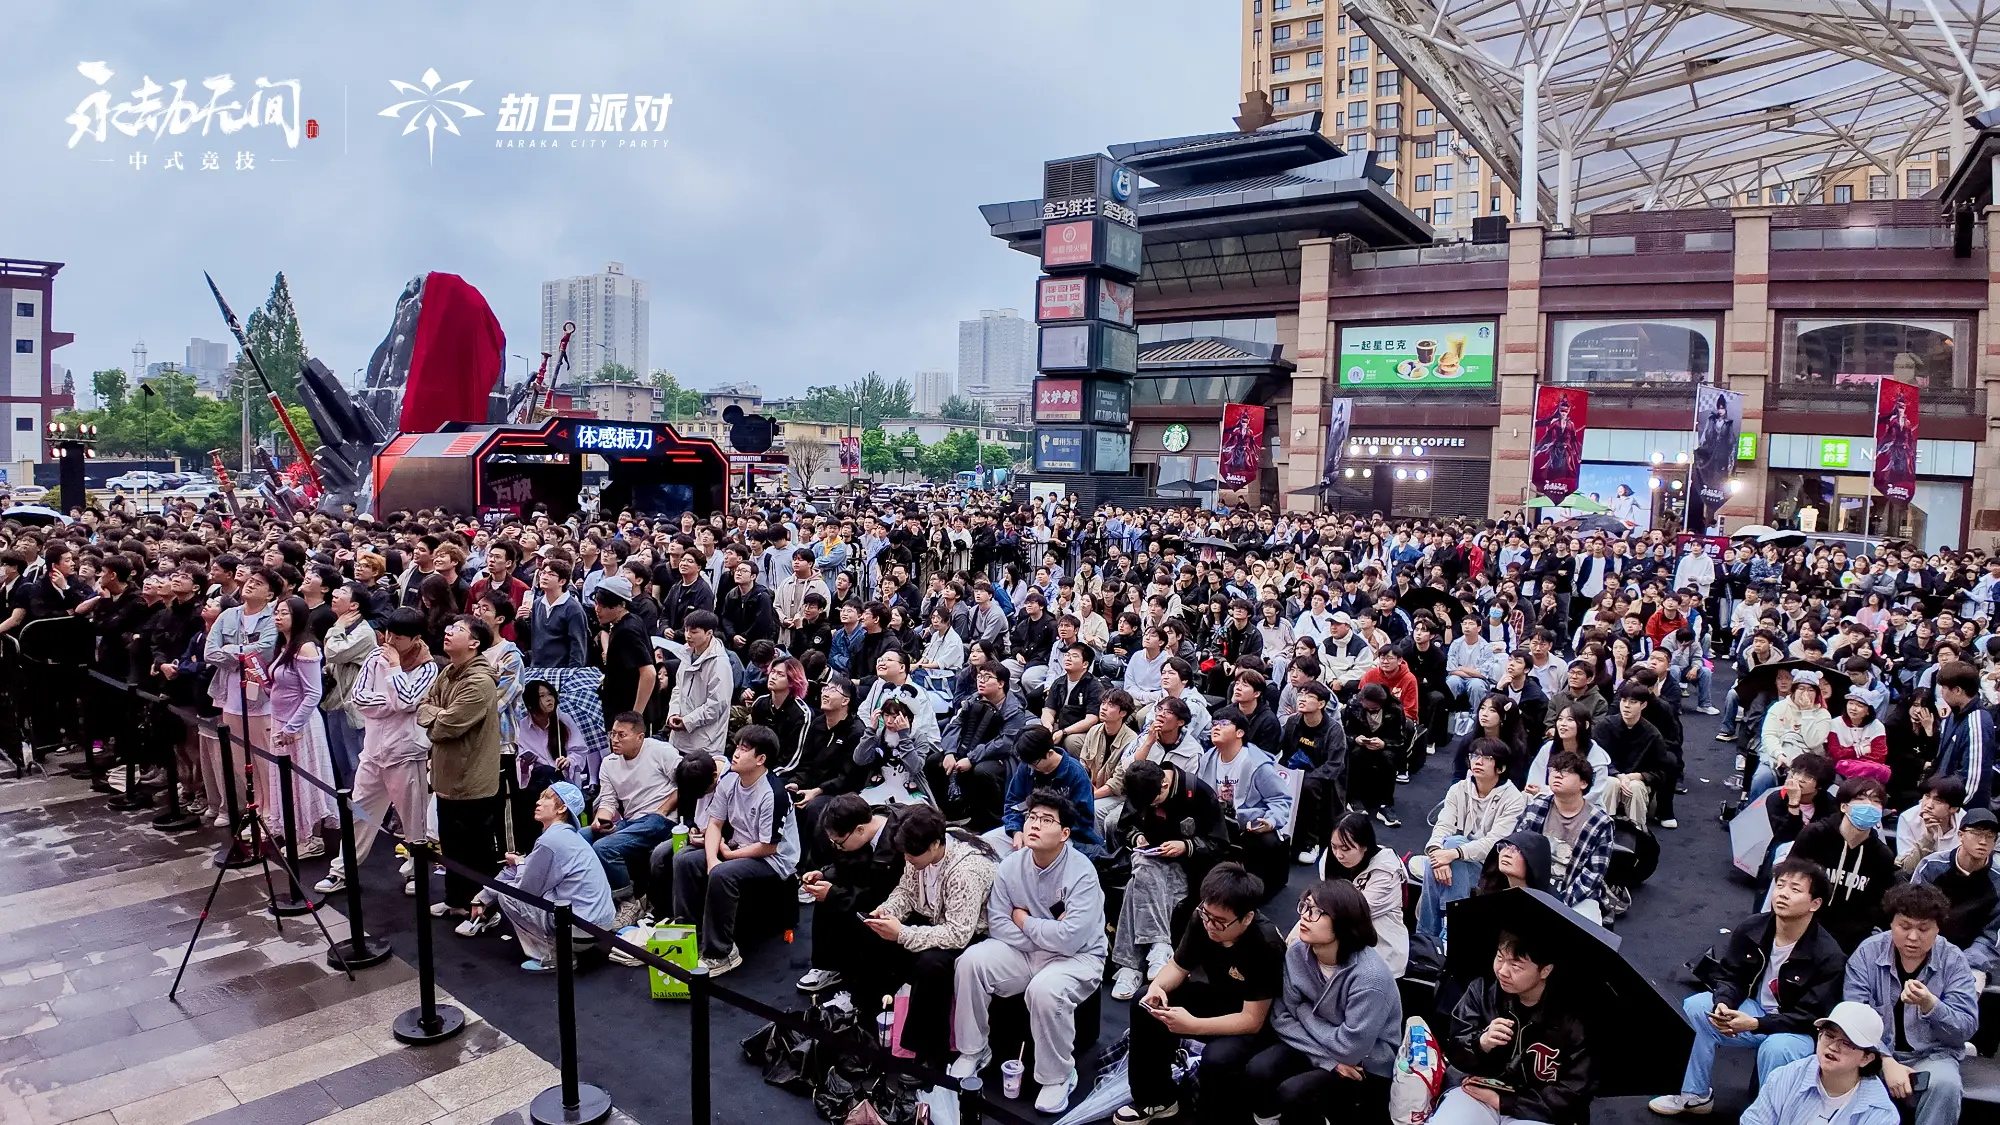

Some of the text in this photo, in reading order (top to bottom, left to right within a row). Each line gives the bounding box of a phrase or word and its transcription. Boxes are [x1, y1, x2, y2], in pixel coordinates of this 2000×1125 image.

[1043, 197, 1096, 219] 盒马鲜生
[1350, 340, 1407, 350] 一起星巴克
[578, 426, 653, 450] 体感振刀
[1350, 437, 1465, 447] STARBUCKS COFFEE
